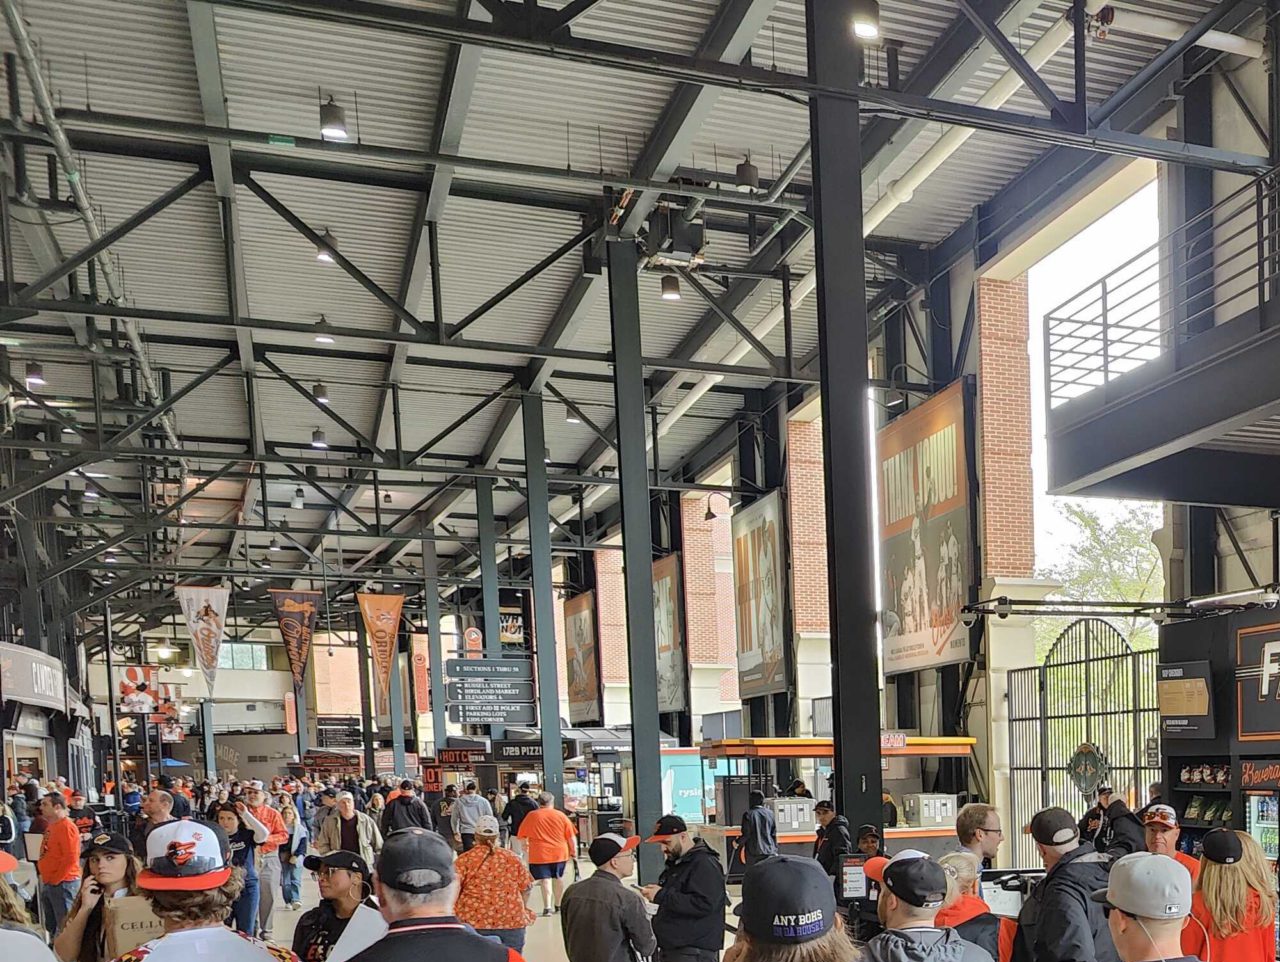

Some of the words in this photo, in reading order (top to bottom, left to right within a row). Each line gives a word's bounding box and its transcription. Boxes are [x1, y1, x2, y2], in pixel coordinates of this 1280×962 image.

[881, 733, 906, 748] EAM
[442, 751, 460, 762] HOT
[521, 746, 543, 756] PIZZ
[773, 915, 797, 926] ANY
[797, 909, 823, 925] BOHS
